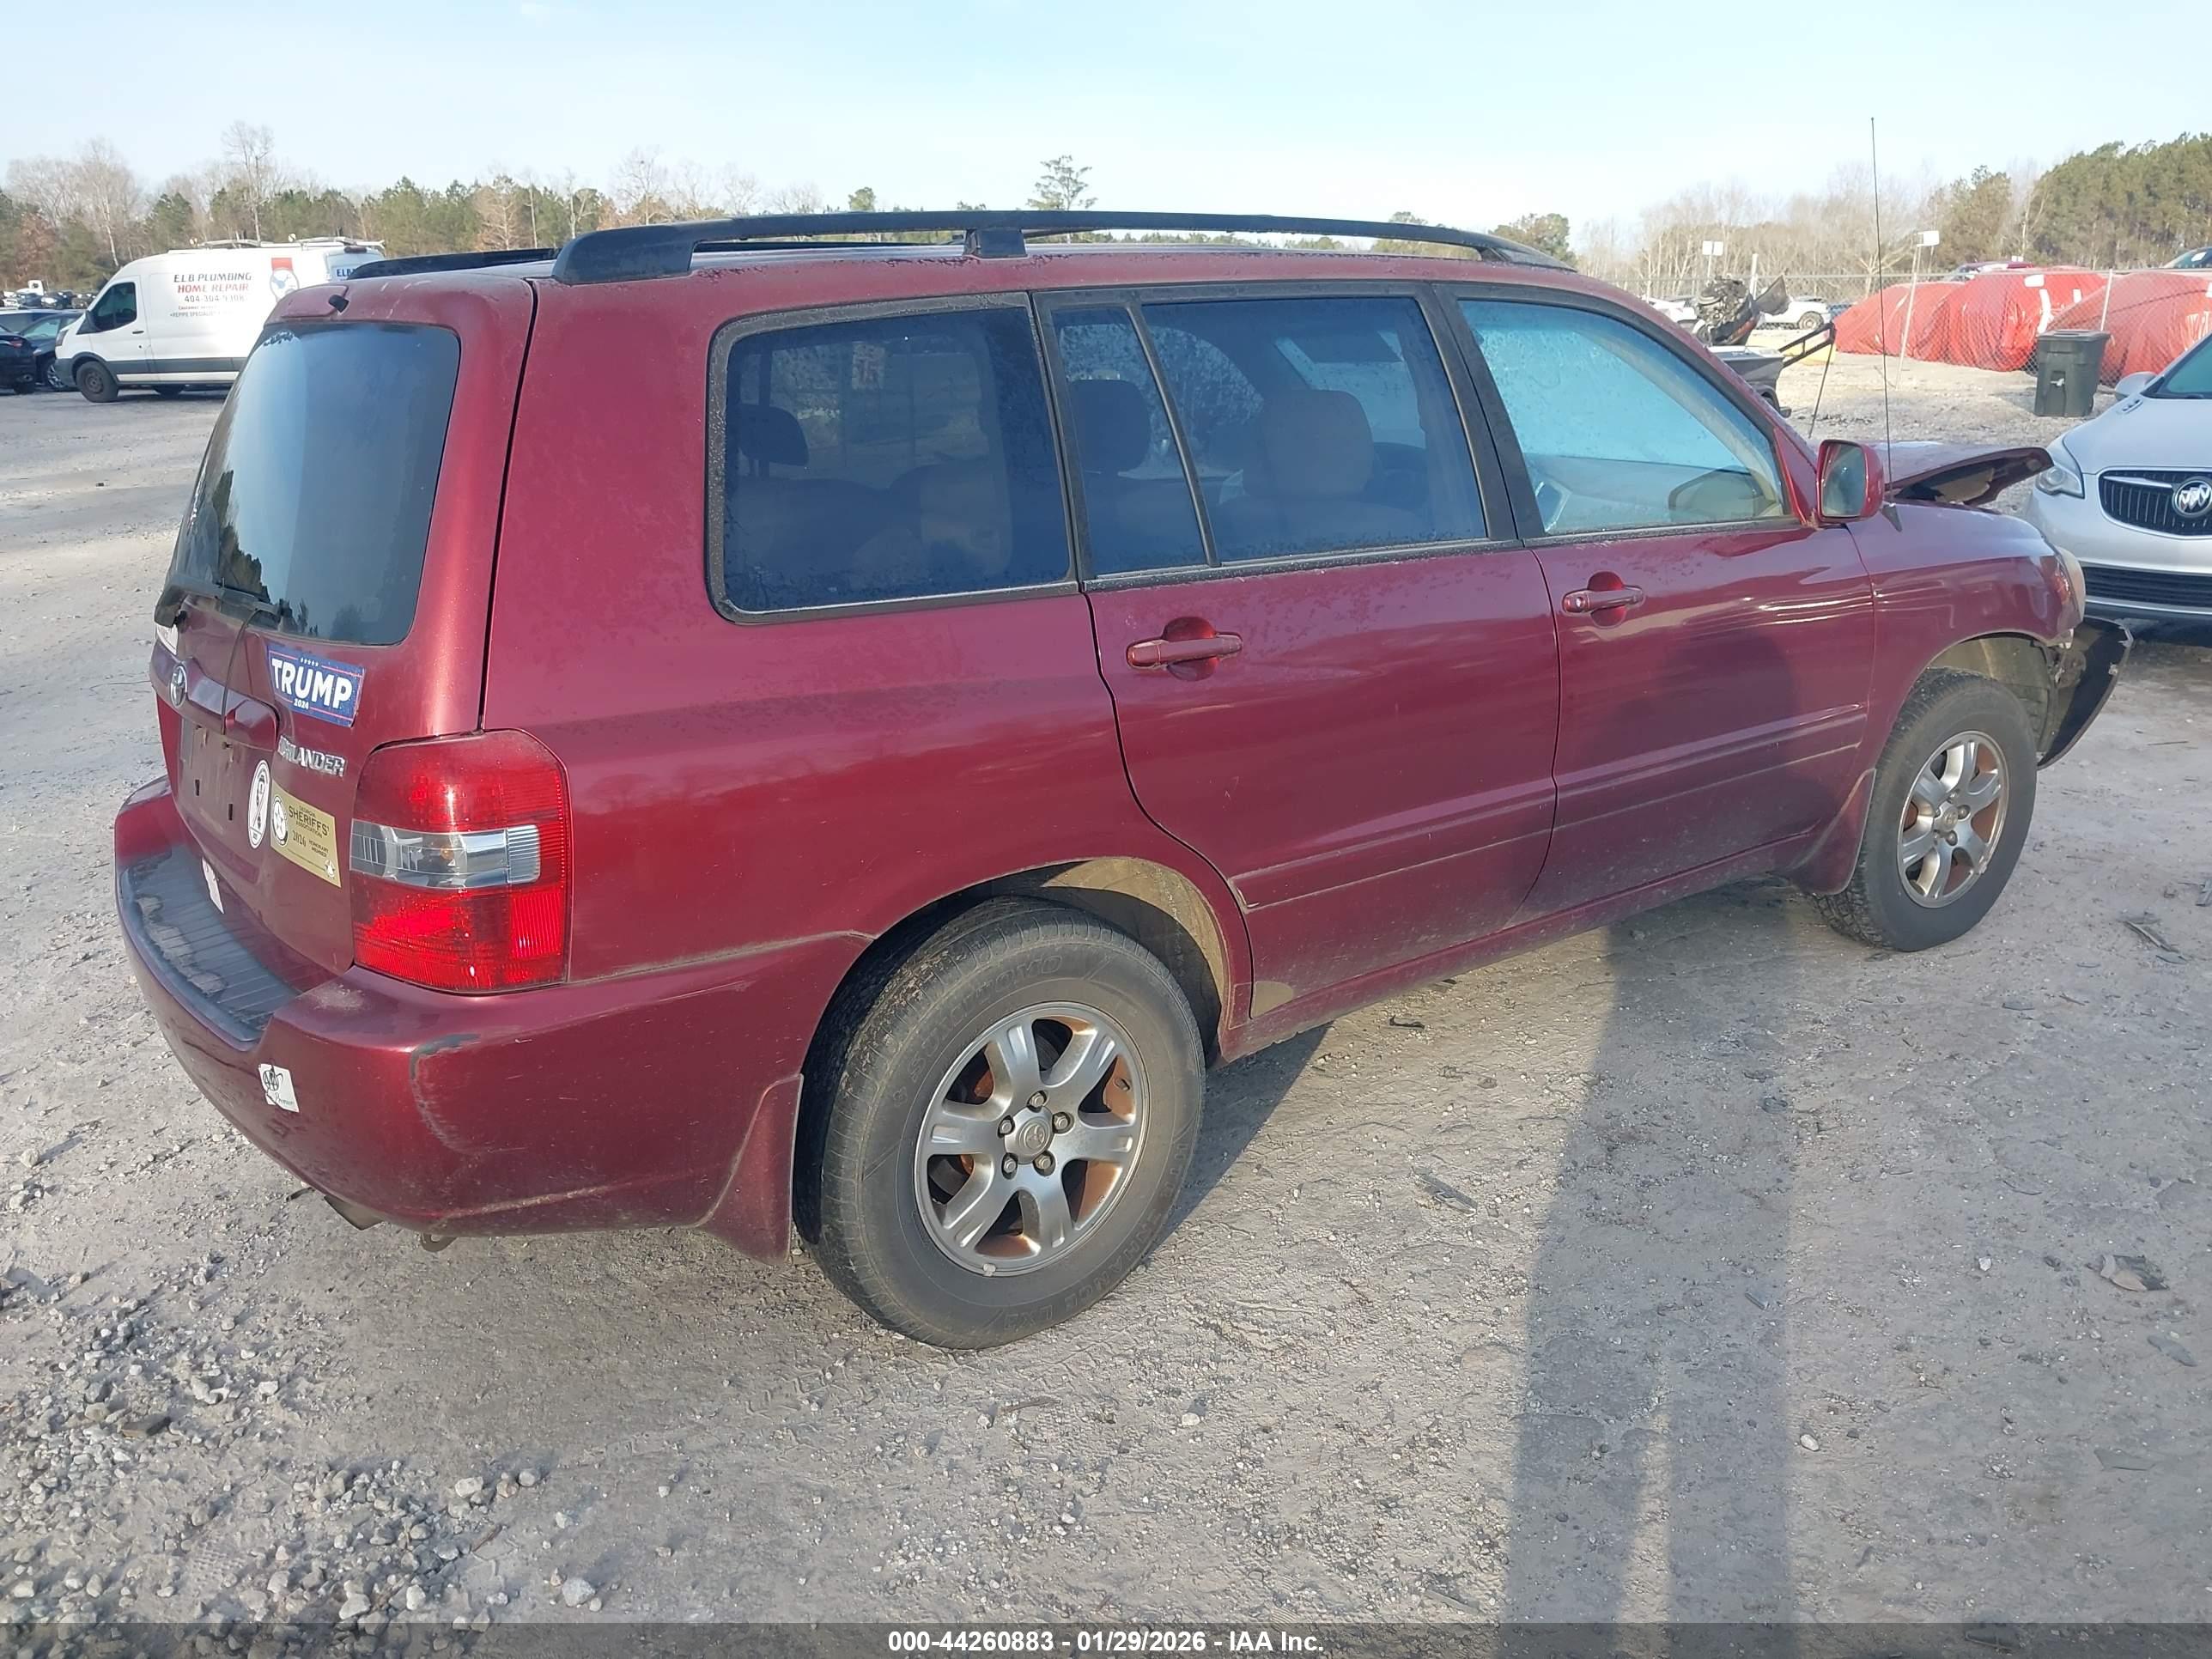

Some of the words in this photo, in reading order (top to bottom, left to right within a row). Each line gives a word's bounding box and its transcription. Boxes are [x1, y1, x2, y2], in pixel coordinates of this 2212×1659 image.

[198, 272, 252, 282] PLUMBING
[178, 284, 208, 293] HOME
[211, 282, 249, 292] REPAIR
[271, 658, 353, 709] TRUMP
[294, 698, 310, 710] 2024
